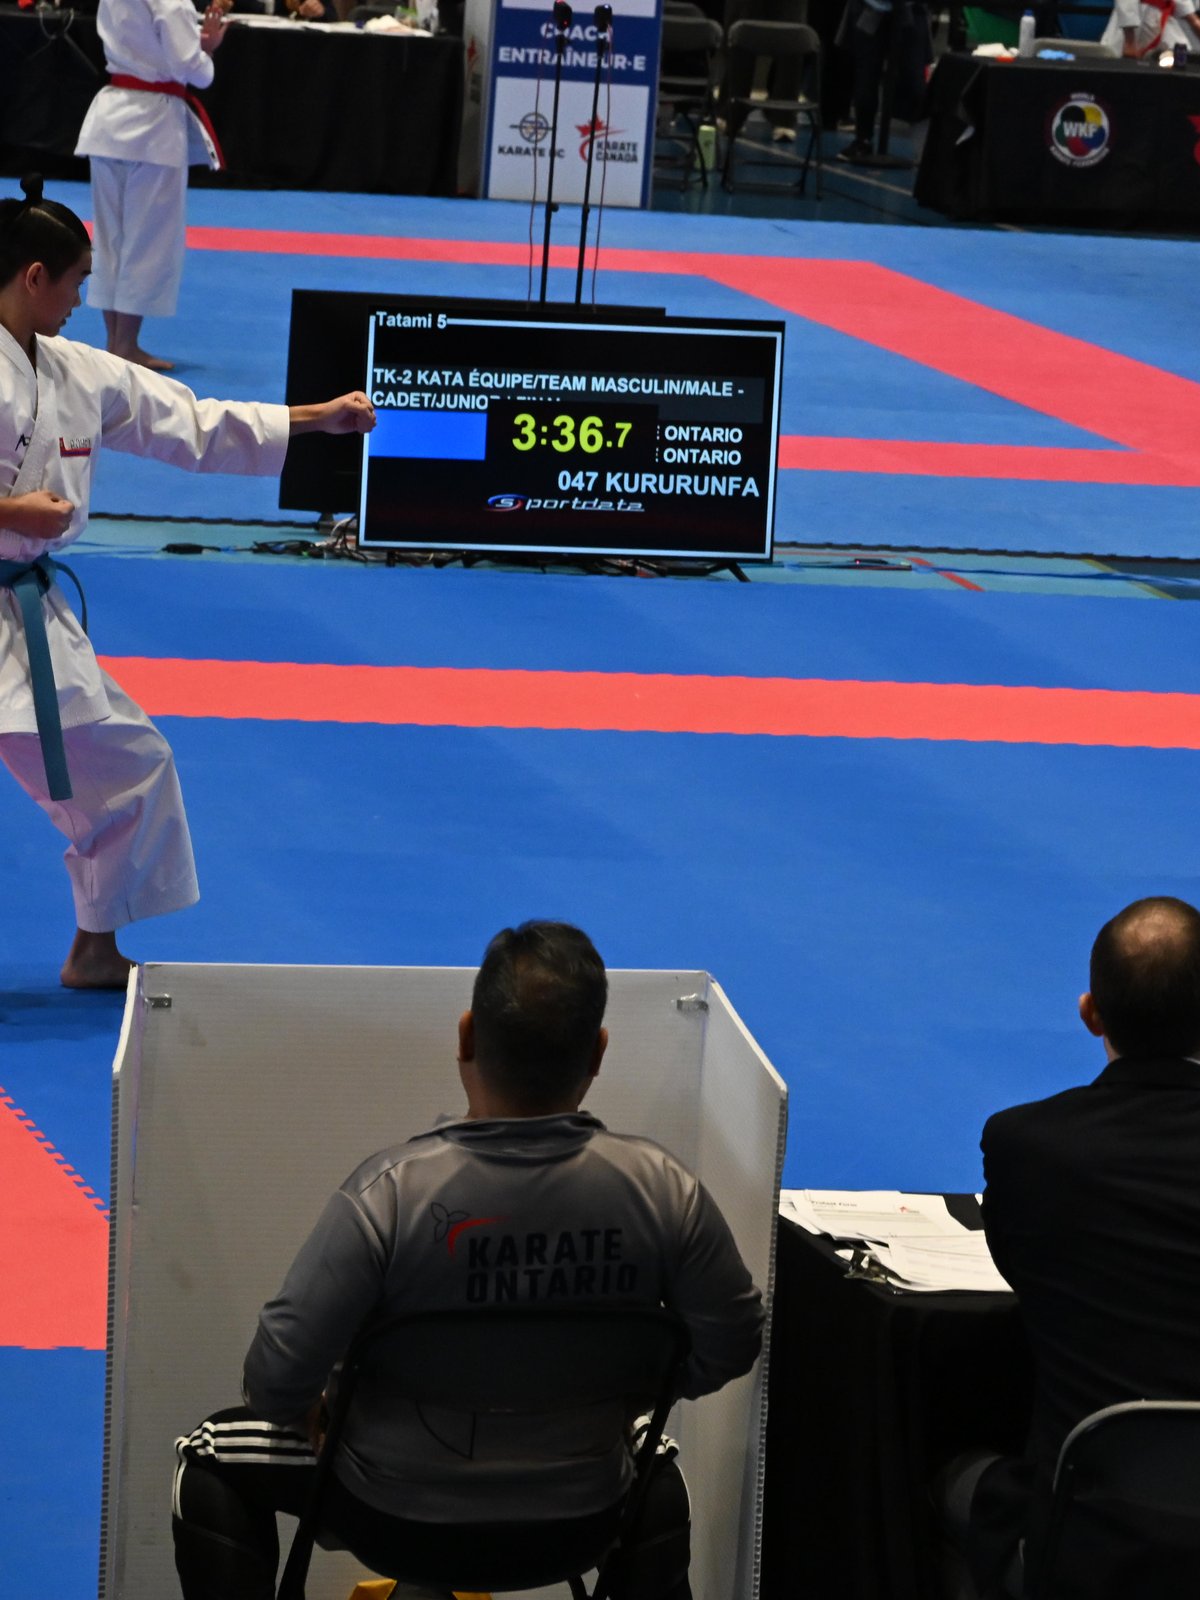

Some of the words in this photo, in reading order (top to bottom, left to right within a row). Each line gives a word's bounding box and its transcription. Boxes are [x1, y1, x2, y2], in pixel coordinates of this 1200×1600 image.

[1063, 121, 1098, 138] WKF
[498, 146, 545, 158] KARATE
[597, 141, 637, 152] KARATE
[596, 152, 637, 164] CANADA
[376, 311, 431, 328] Tatami
[437, 314, 446, 329] 5
[374, 368, 411, 384] TK-2
[417, 370, 463, 386] KATA
[469, 368, 585, 391] ÉQUIPE/TEAM
[591, 376, 732, 397] MASCULIN/MALE
[372, 391, 500, 410] CADET/JUNIO
[512, 413, 632, 454] 3:36.7
[664, 425, 742, 443] ONTARIO
[663, 448, 741, 465] ONTARIO
[558, 470, 598, 491] 047
[605, 472, 760, 497] KURURUNFA
[468, 1228, 623, 1268] KARATE
[466, 1263, 637, 1303] ONTARIO
